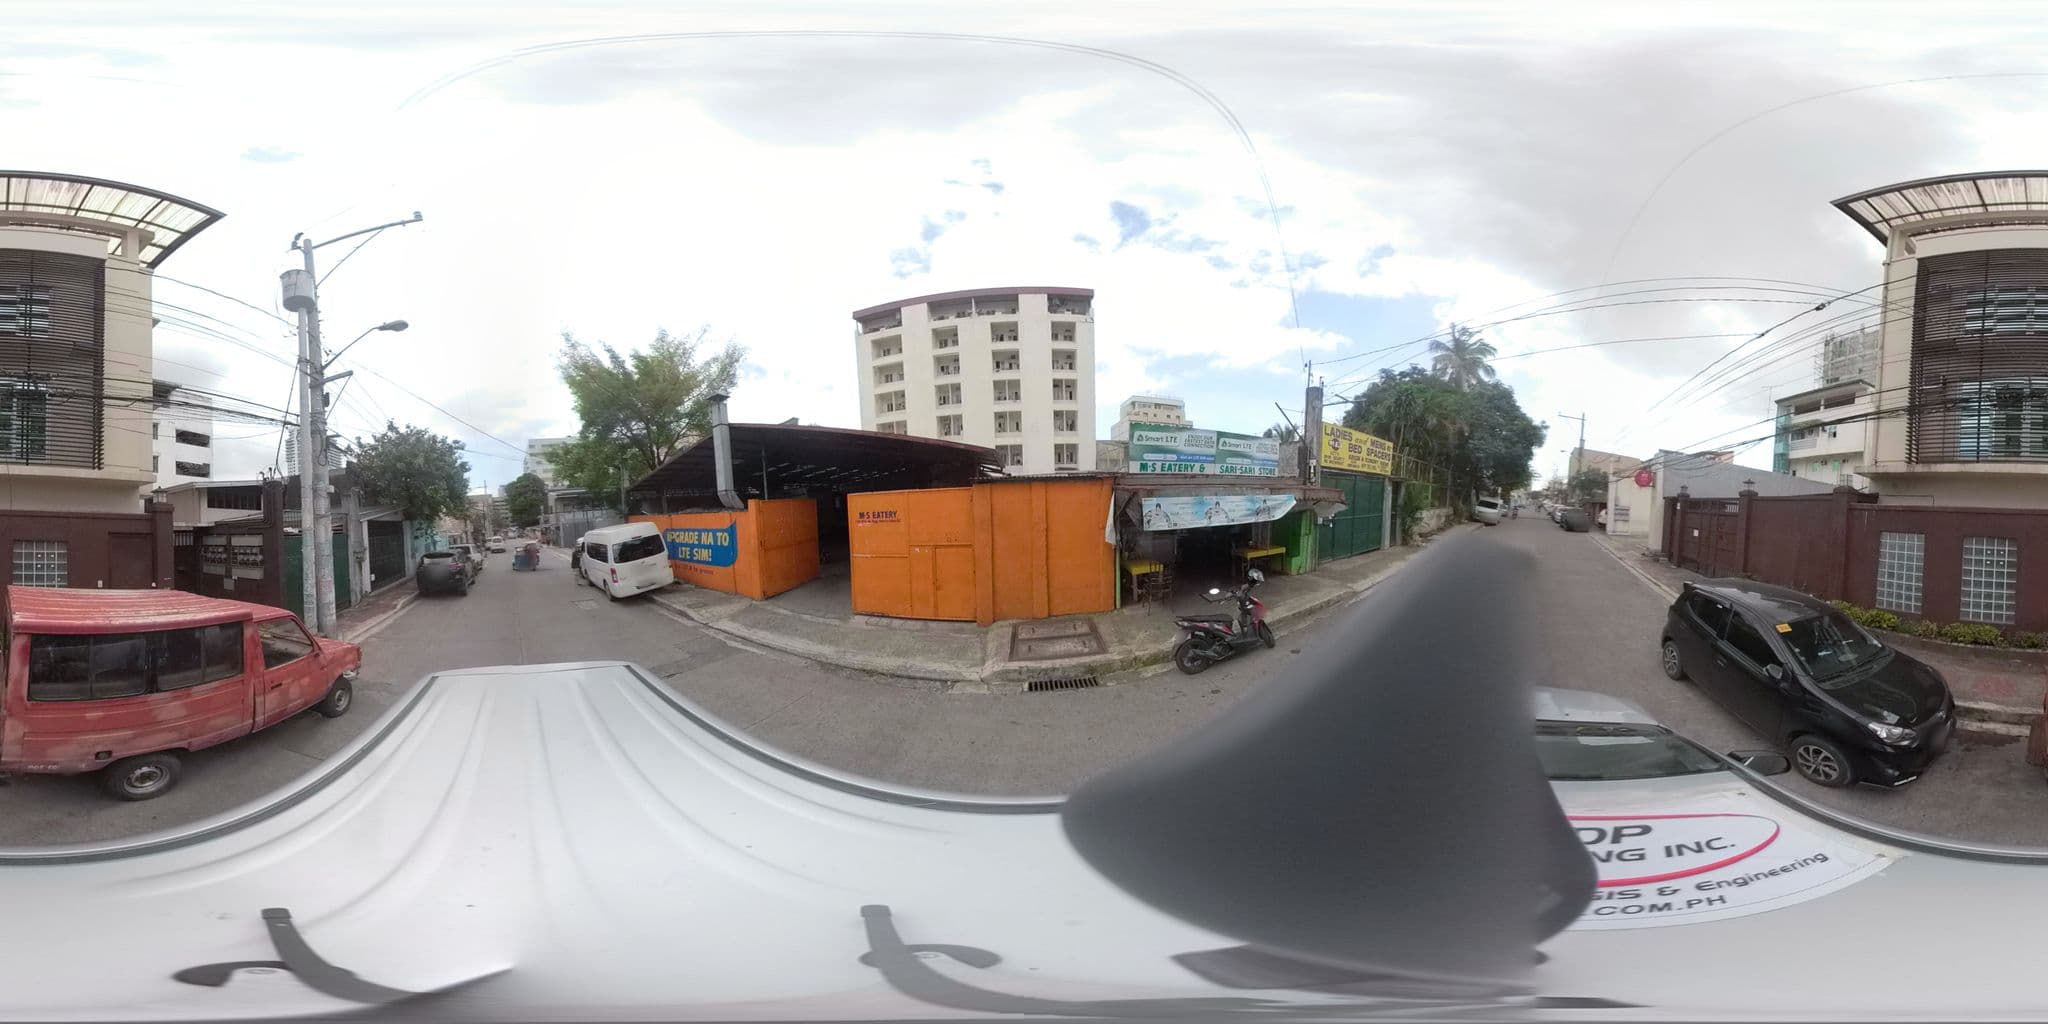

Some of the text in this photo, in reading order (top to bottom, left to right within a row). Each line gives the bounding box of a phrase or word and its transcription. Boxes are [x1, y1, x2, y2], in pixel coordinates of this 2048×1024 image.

[1145, 433, 1179, 444] Smart LTE
[1324, 424, 1352, 441] LADIES
[1348, 443, 1363, 455] BED
[1160, 463, 1196, 473] EATERY
[1219, 465, 1256, 475] SARI-SARI
[1258, 467, 1276, 476] STORE
[872, 509, 898, 519] EATERY
[701, 532, 714, 545] NA
[716, 532, 730, 547] TO
[678, 546, 713, 562] LTE SIM!
[1663, 836, 1737, 858] INC.
[1656, 886, 1681, 896] &
[1694, 852, 1830, 892] Engineering
